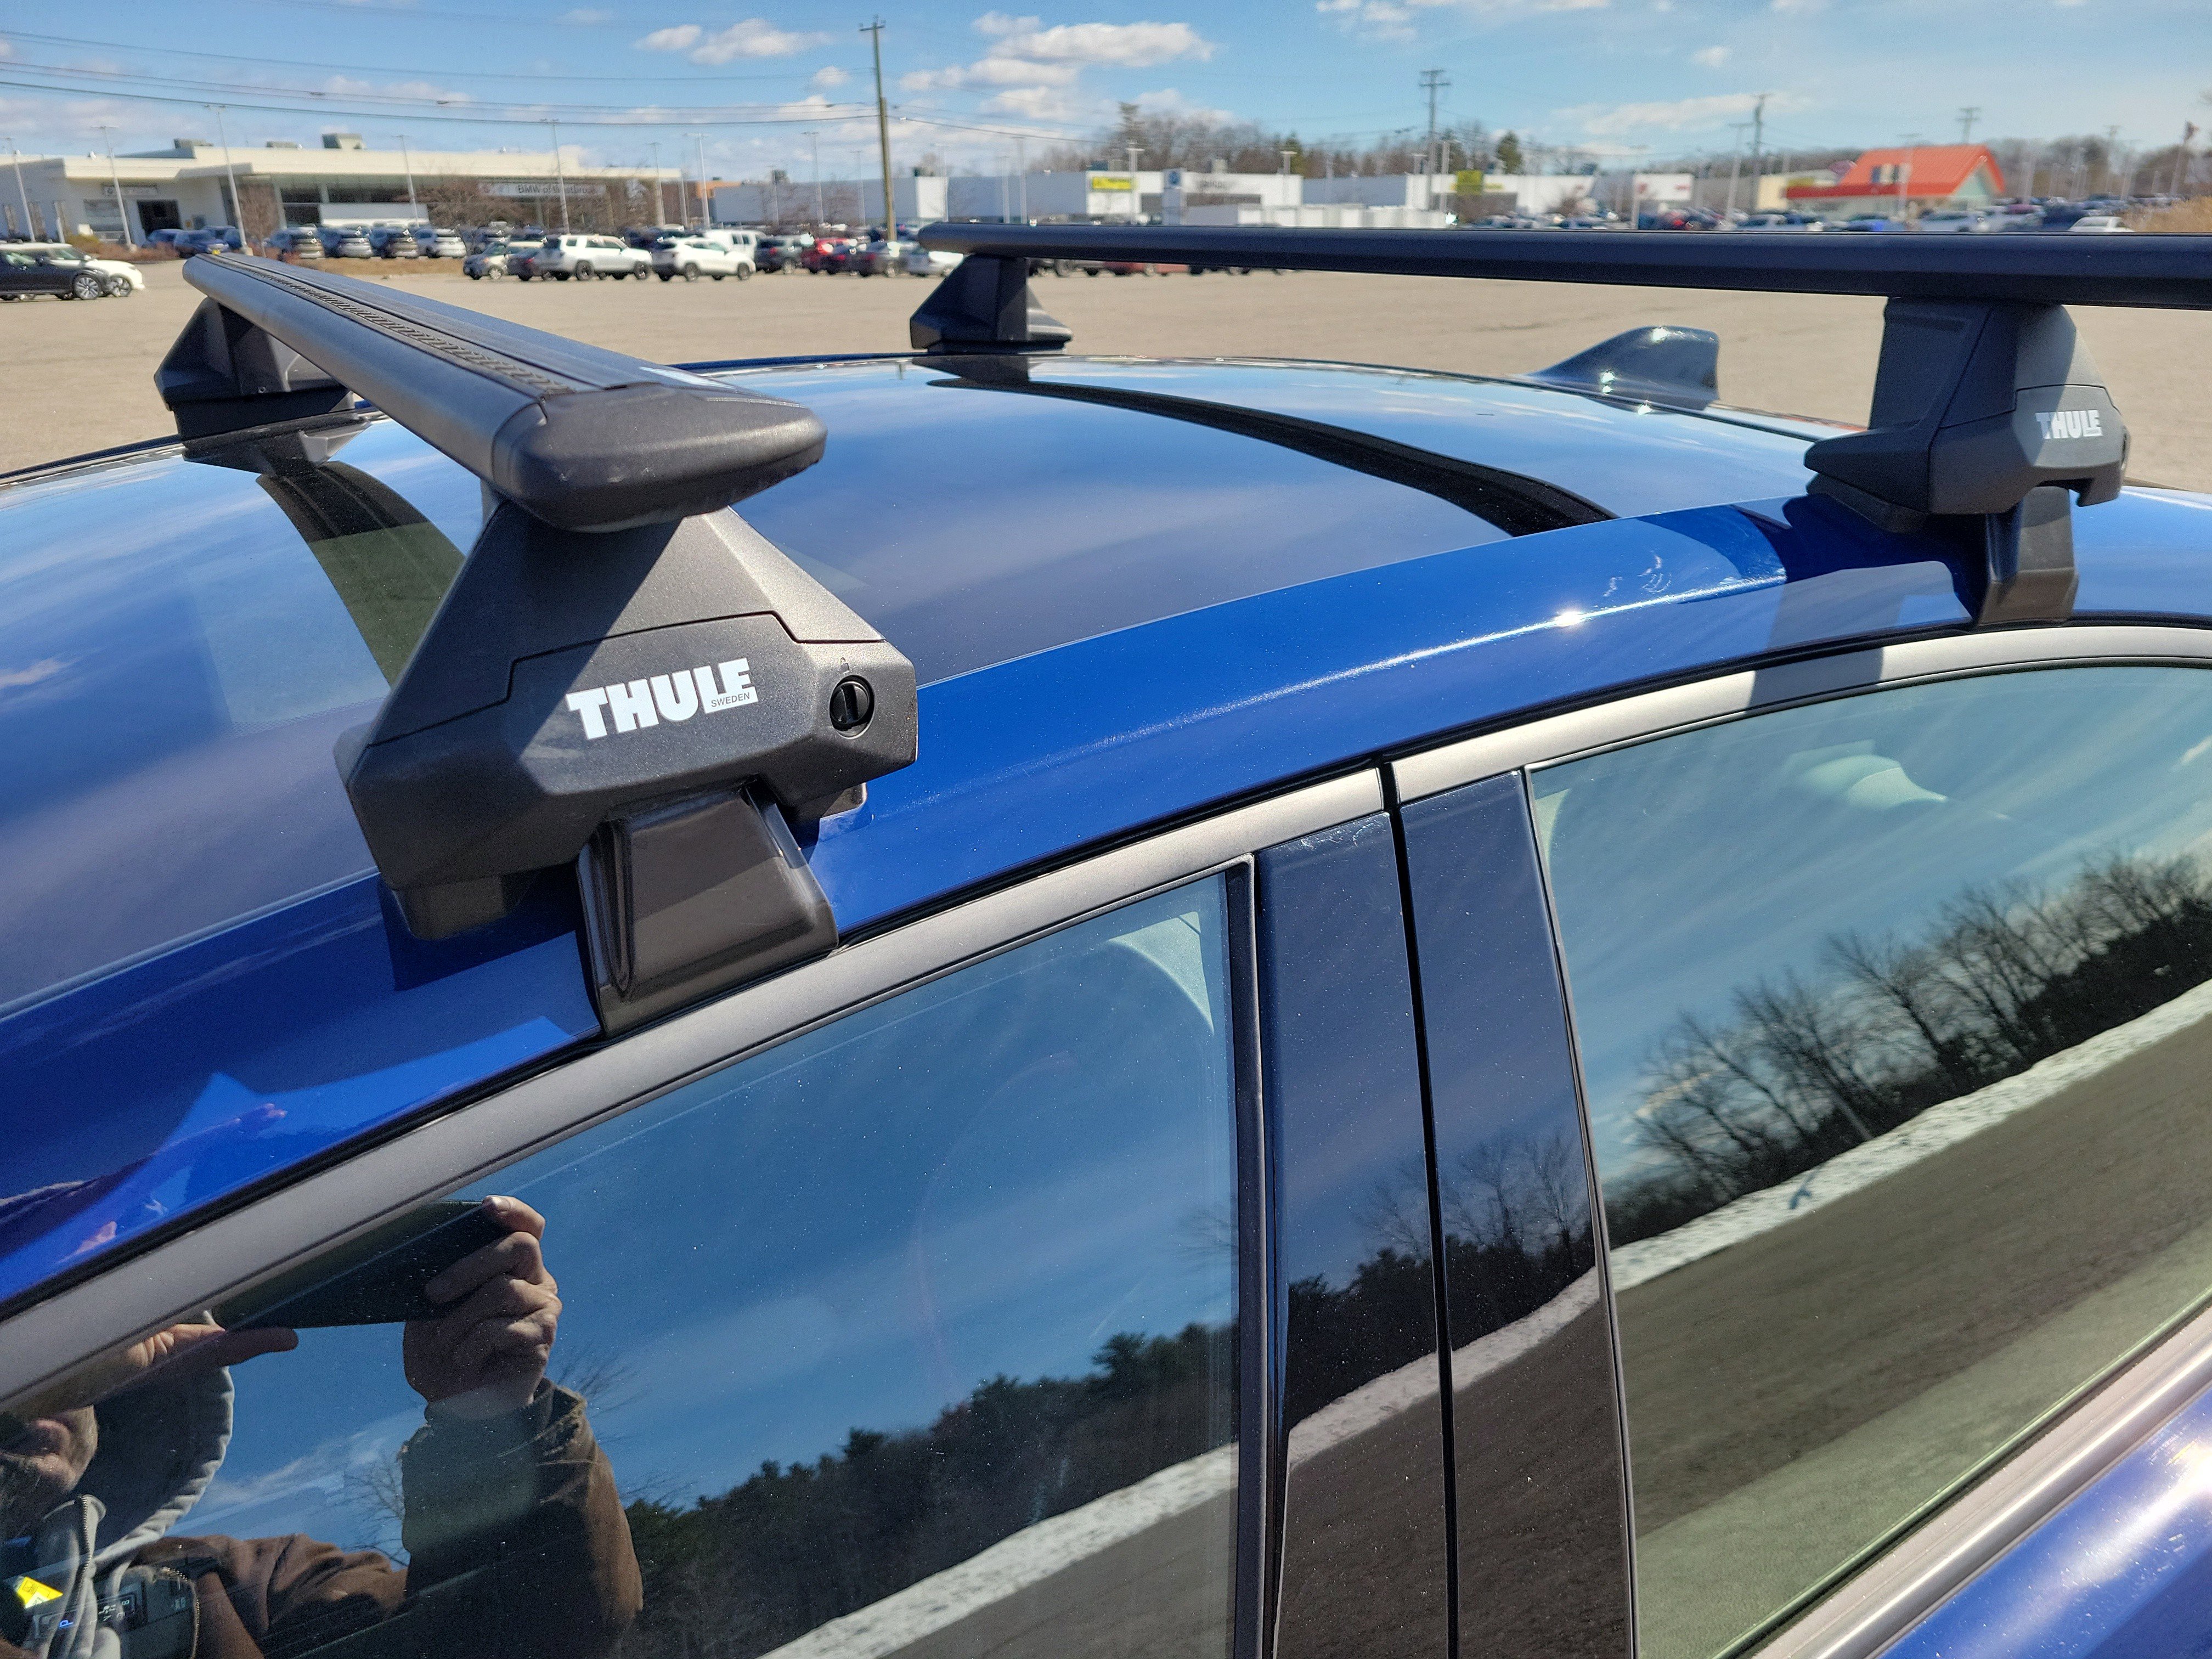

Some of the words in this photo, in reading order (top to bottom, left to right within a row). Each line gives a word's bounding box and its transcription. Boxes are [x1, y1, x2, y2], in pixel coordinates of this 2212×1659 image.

[517, 184, 540, 193] BMW
[2035, 409, 2103, 439] THULE
[565, 657, 759, 740] THULE
[711, 692, 750, 707] SWEDEN
